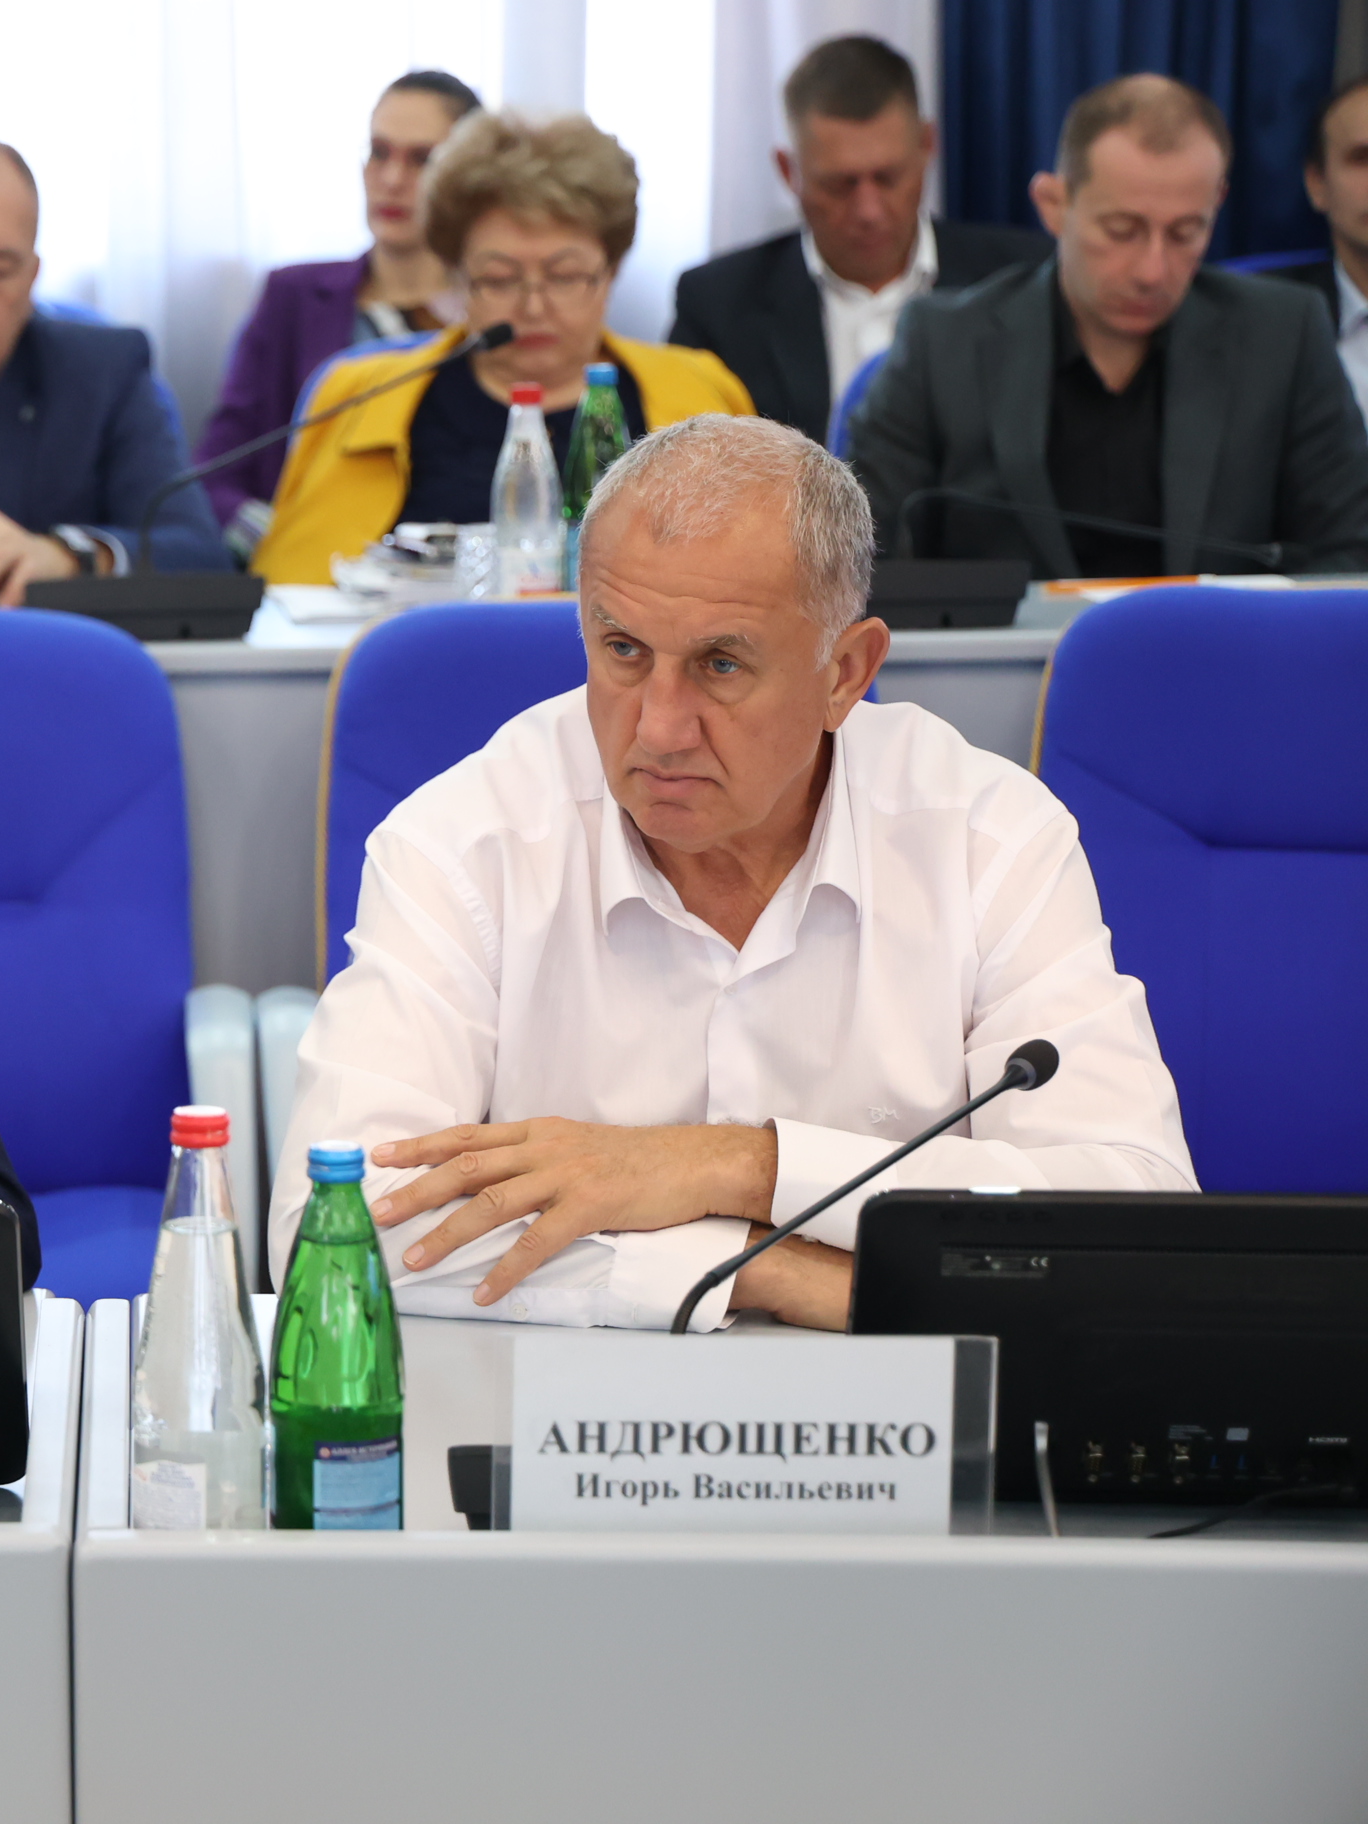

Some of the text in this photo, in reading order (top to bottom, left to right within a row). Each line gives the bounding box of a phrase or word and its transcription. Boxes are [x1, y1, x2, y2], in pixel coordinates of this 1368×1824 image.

[538, 1420, 937, 1463] АНДРЮЩЕНКО
[575, 1473, 897, 1506] Игорь Васильевич
